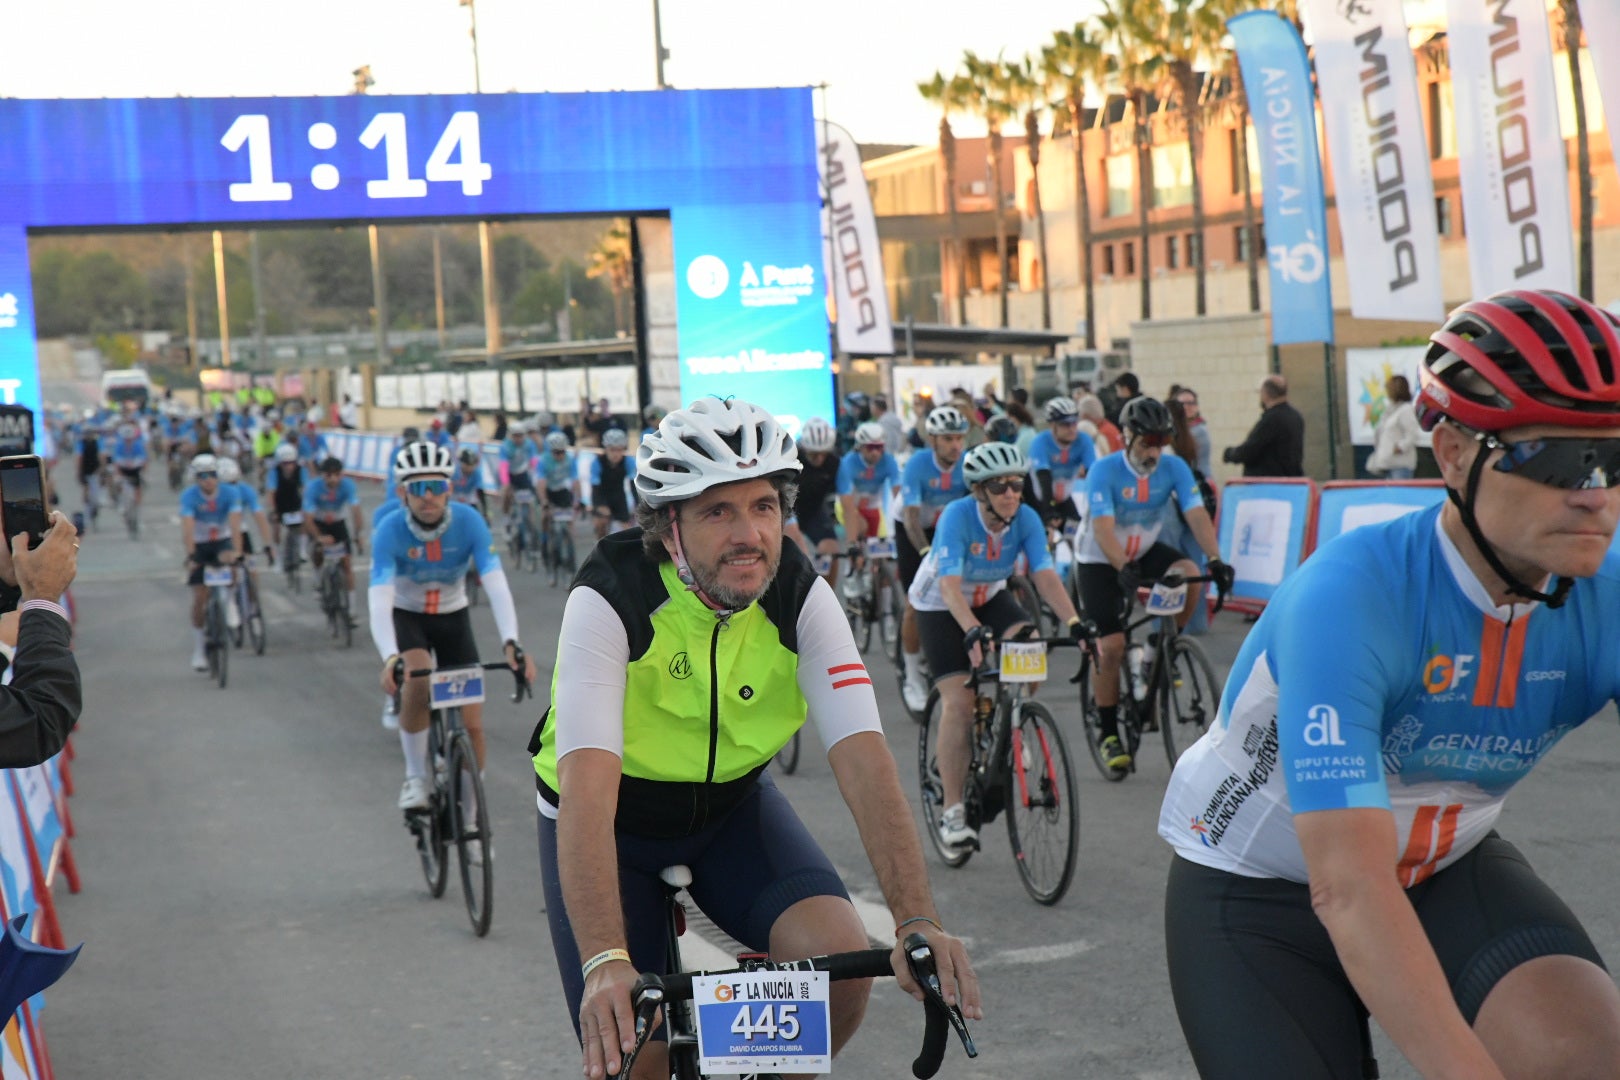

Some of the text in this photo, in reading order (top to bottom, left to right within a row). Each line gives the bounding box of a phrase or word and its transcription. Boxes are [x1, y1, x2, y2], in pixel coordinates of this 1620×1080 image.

[220, 110, 492, 202] 1:14
[1294, 755, 1366, 770] DIPUTACIÓ
[1296, 768, 1367, 783] D'ALACANT
[1208, 782, 1256, 846] VALENCIANA
[746, 982, 760, 999] LA
[763, 977, 794, 999] NUCÍA
[800, 982, 809, 999] 2025
[731, 1004, 800, 1040] 445
[730, 1045, 750, 1053] DAVID
